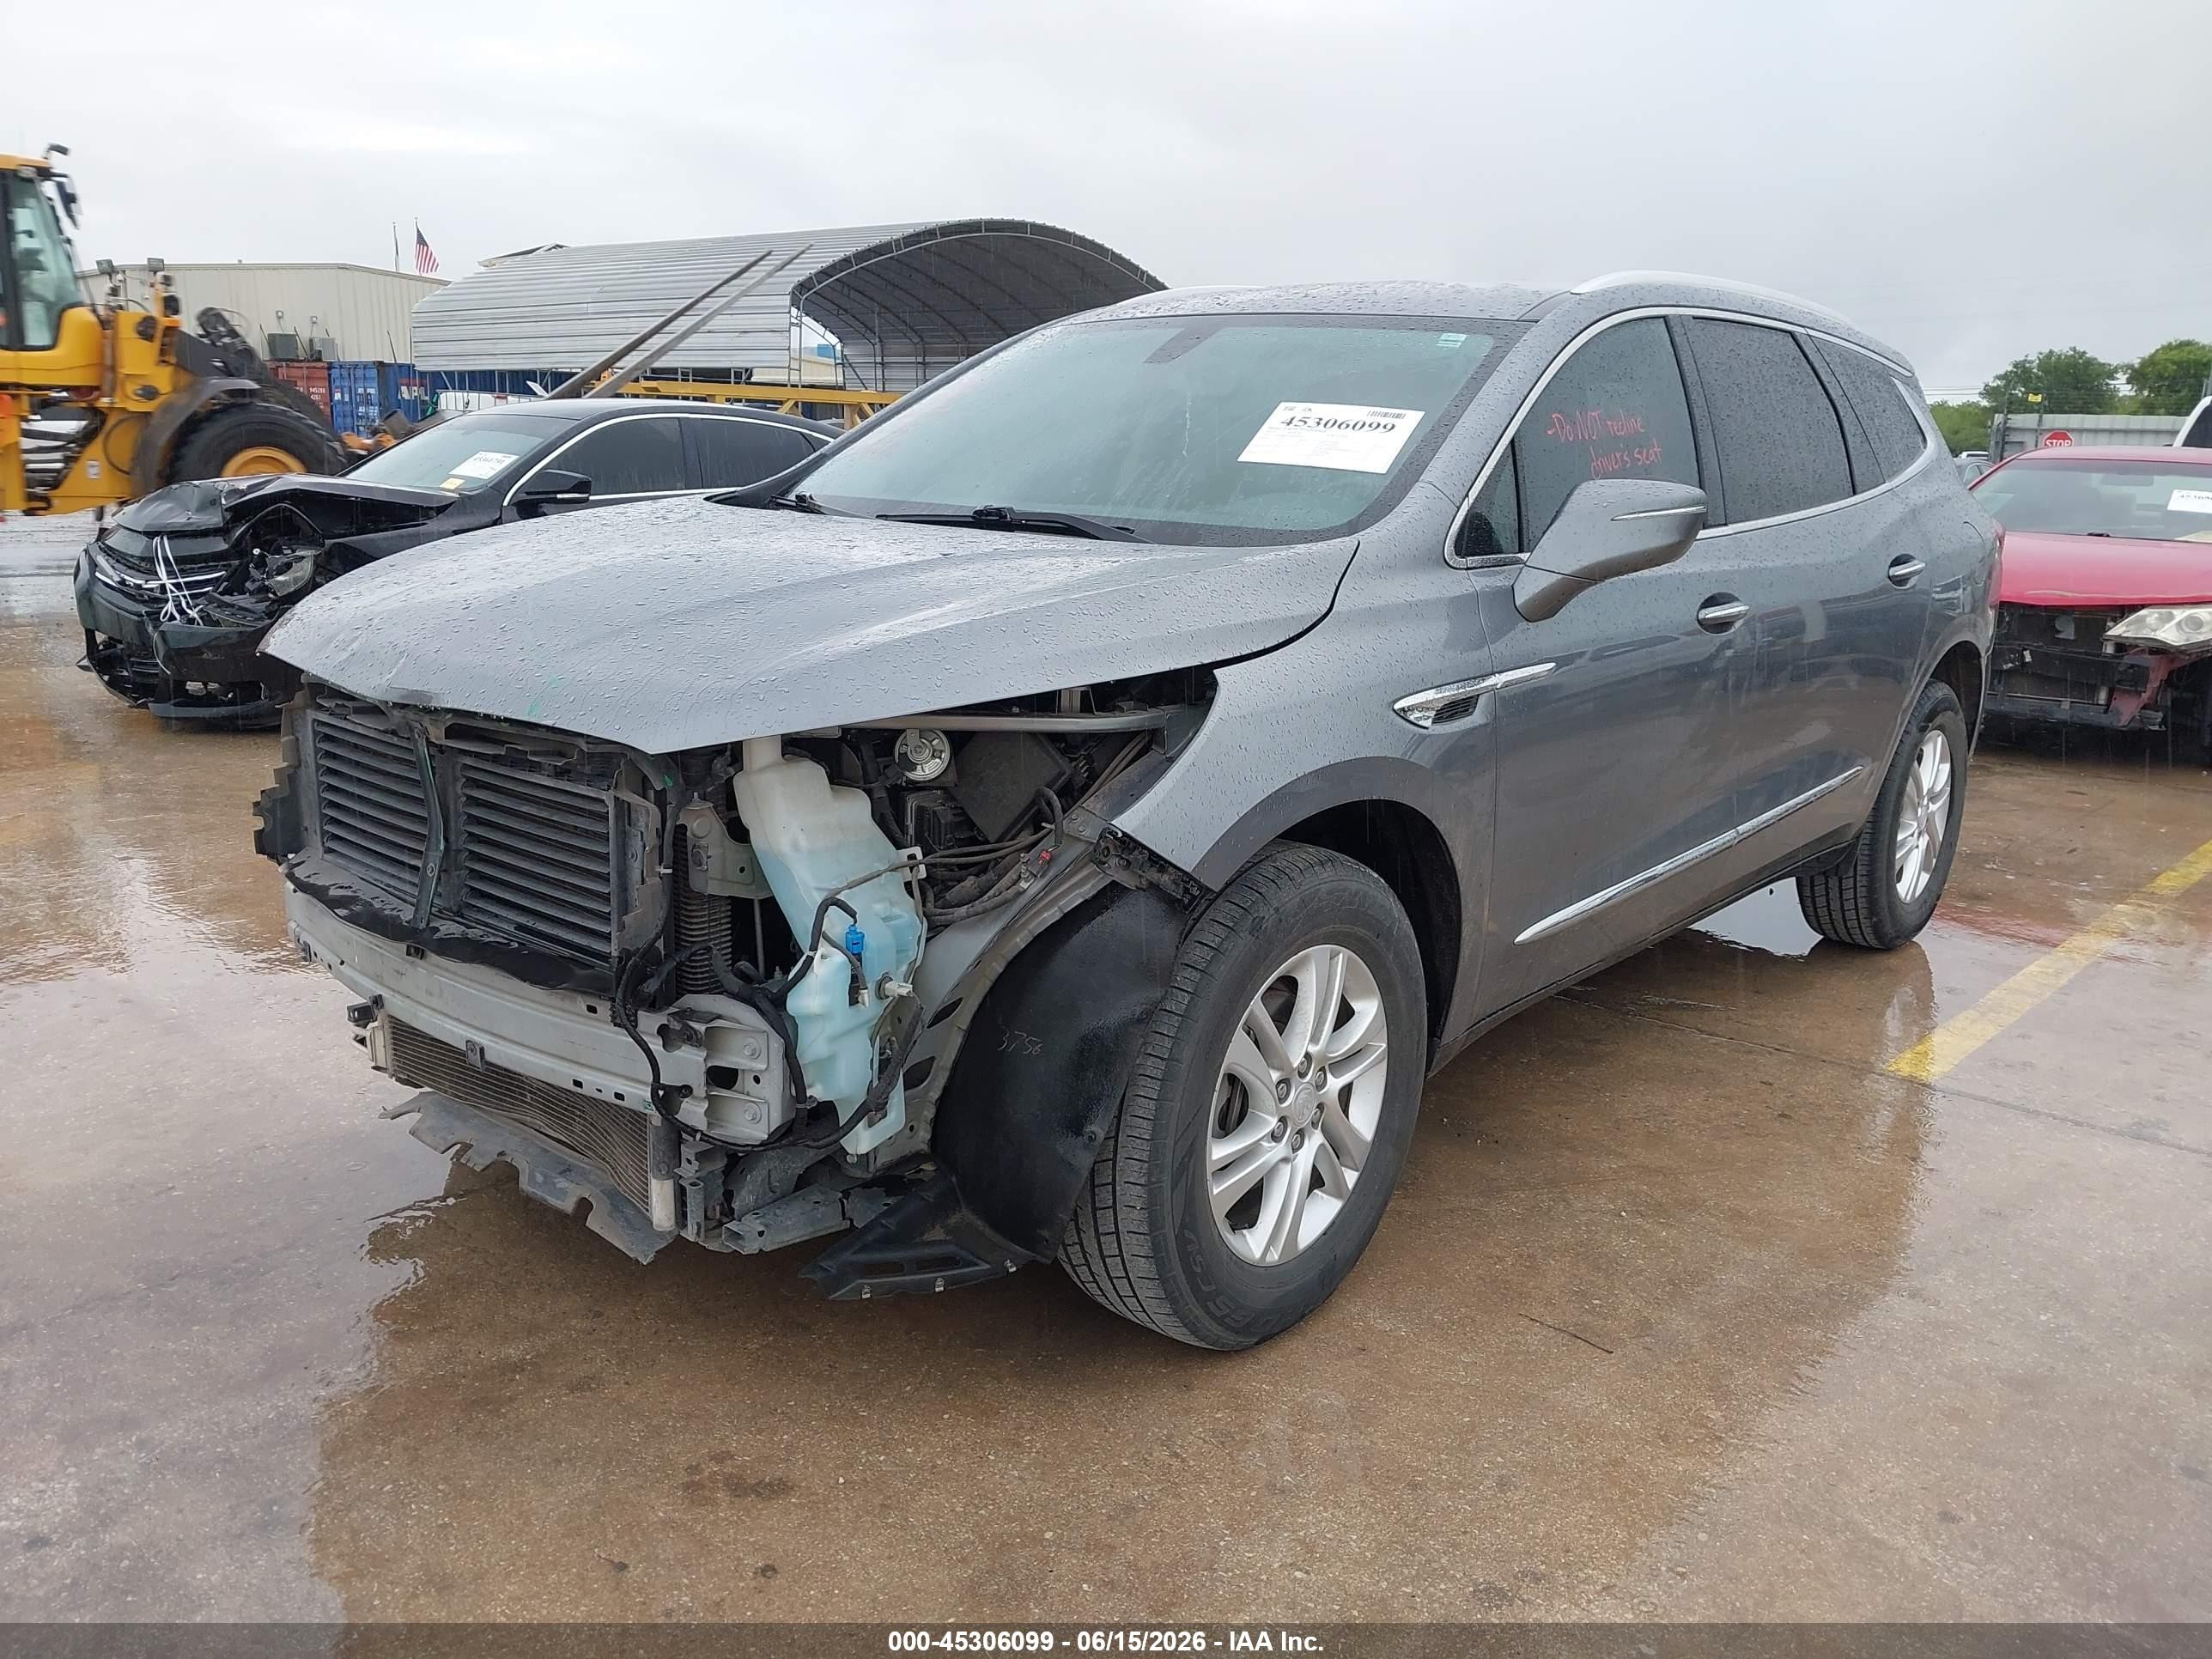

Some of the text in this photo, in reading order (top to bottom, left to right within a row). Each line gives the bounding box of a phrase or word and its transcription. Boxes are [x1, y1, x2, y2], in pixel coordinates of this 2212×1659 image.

[1281, 415, 1396, 434] 45306099
[1576, 410, 1601, 441] NOT
[1633, 438, 1663, 465] seat
